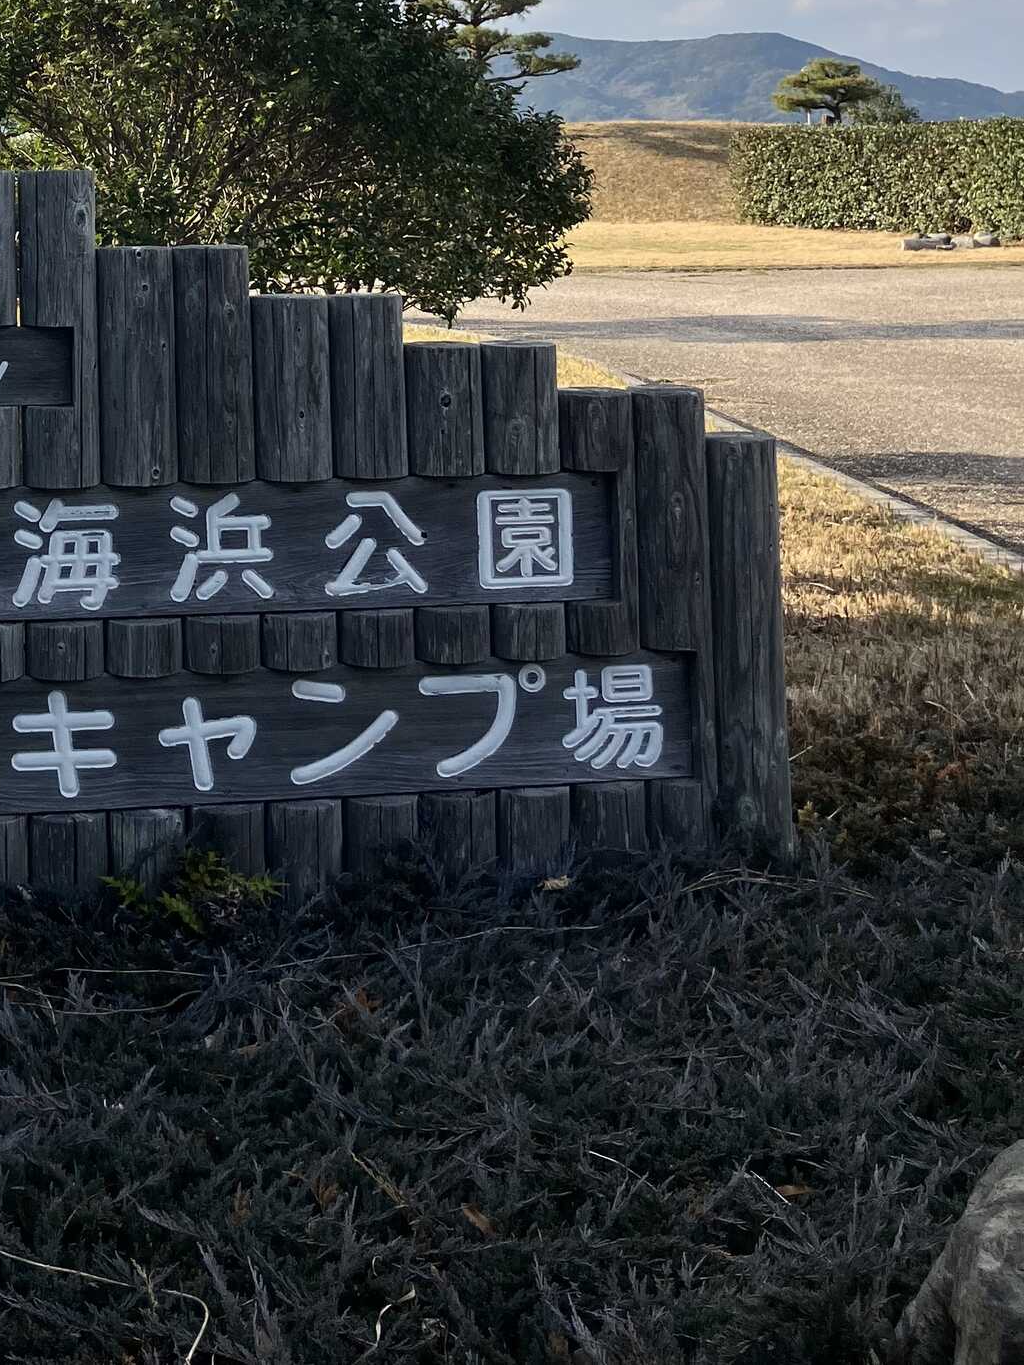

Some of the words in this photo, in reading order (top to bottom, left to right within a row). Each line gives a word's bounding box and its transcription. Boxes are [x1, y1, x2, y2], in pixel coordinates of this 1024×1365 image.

[10, 663, 666, 798] キャンプ場
